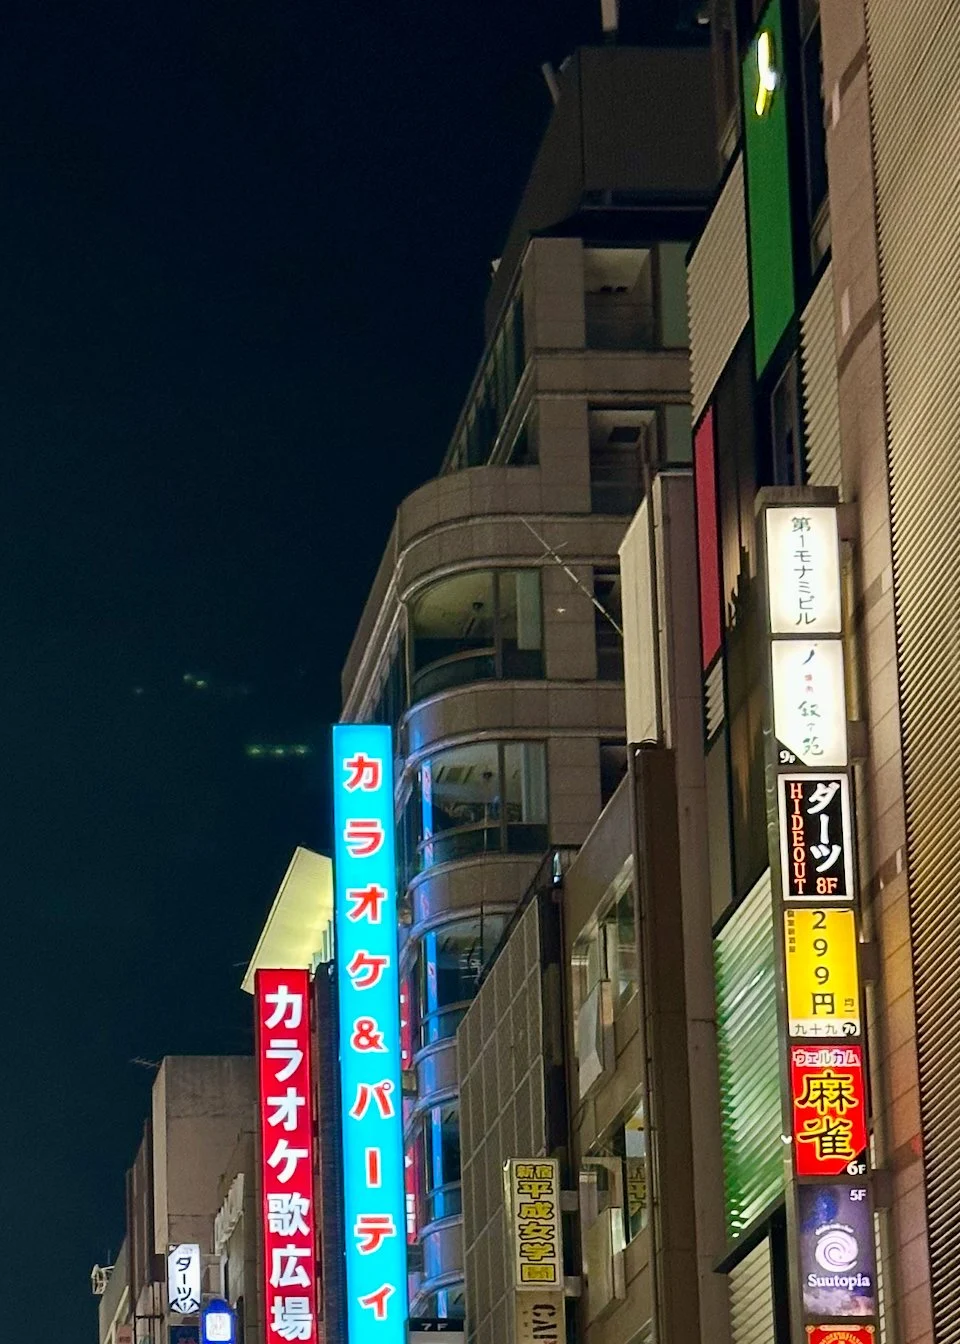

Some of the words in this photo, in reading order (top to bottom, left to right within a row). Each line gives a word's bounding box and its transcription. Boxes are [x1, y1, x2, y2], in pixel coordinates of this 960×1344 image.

[780, 750, 796, 765] 9F
[807, 781, 841, 873] ダーツ
[790, 783, 806, 895] HIDEOUT
[817, 877, 838, 895] 8F
[812, 911, 835, 1015] 299円
[795, 1024, 838, 1036] 九十九
[795, 1050, 861, 1065] ウェルカム
[797, 1071, 858, 1158] 麻雀
[264, 985, 313, 1340] カラオケ歌広場
[846, 1160, 866, 1176] 6F
[850, 1189, 866, 1201] 5F
[176, 1257, 192, 1301] ダーツ
[808, 1274, 870, 1291] Suutopia
[421, 1323, 448, 1331] 7F
